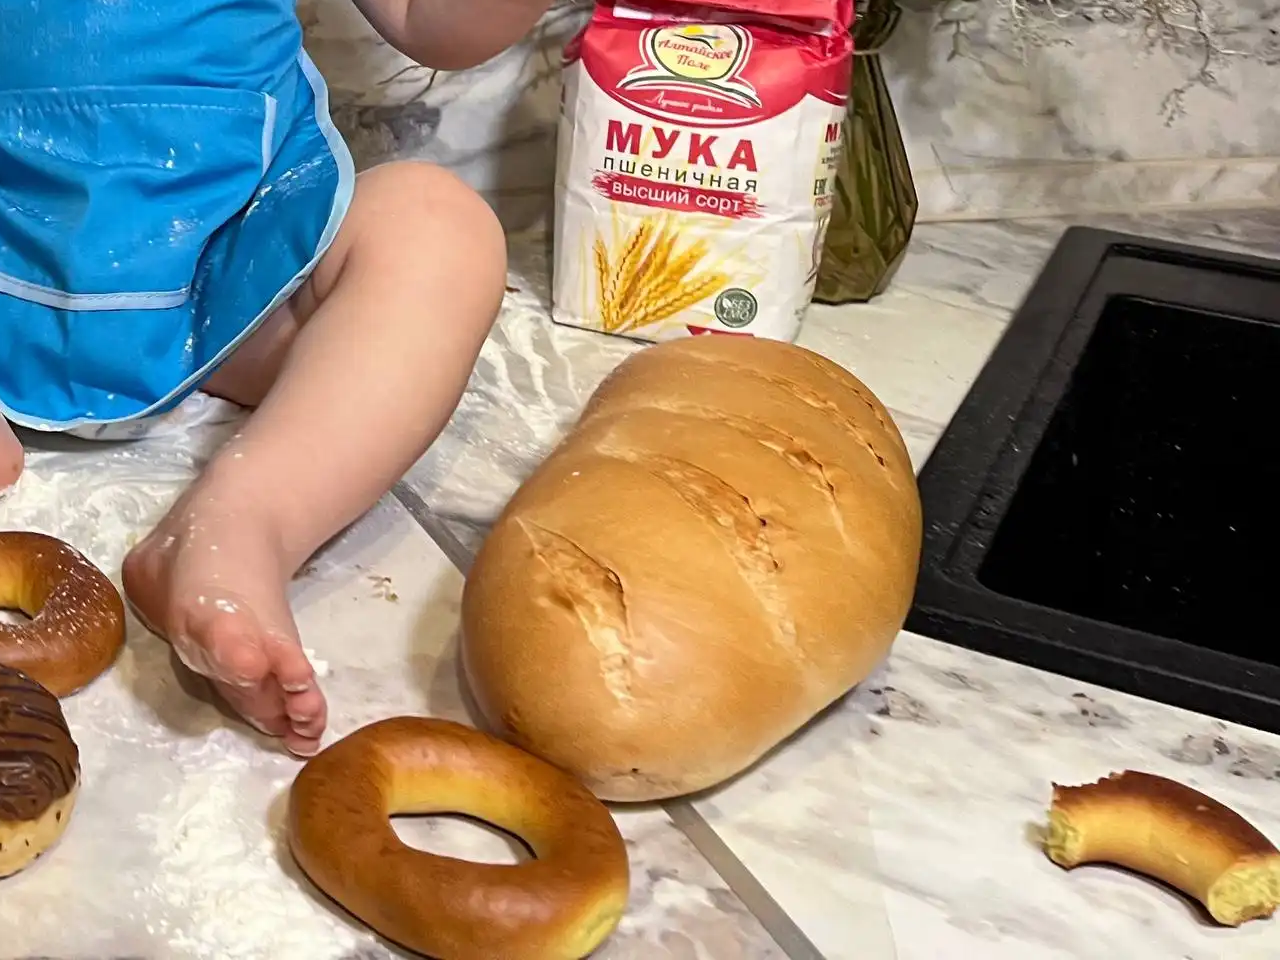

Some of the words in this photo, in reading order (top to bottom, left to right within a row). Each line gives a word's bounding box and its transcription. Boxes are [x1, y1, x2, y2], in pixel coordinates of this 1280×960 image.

[676, 53, 712, 72] Поле
[605, 119, 758, 173] МУКА
[603, 156, 758, 193] пшеничная
[612, 181, 690, 206] высший
[696, 194, 741, 213] сорт
